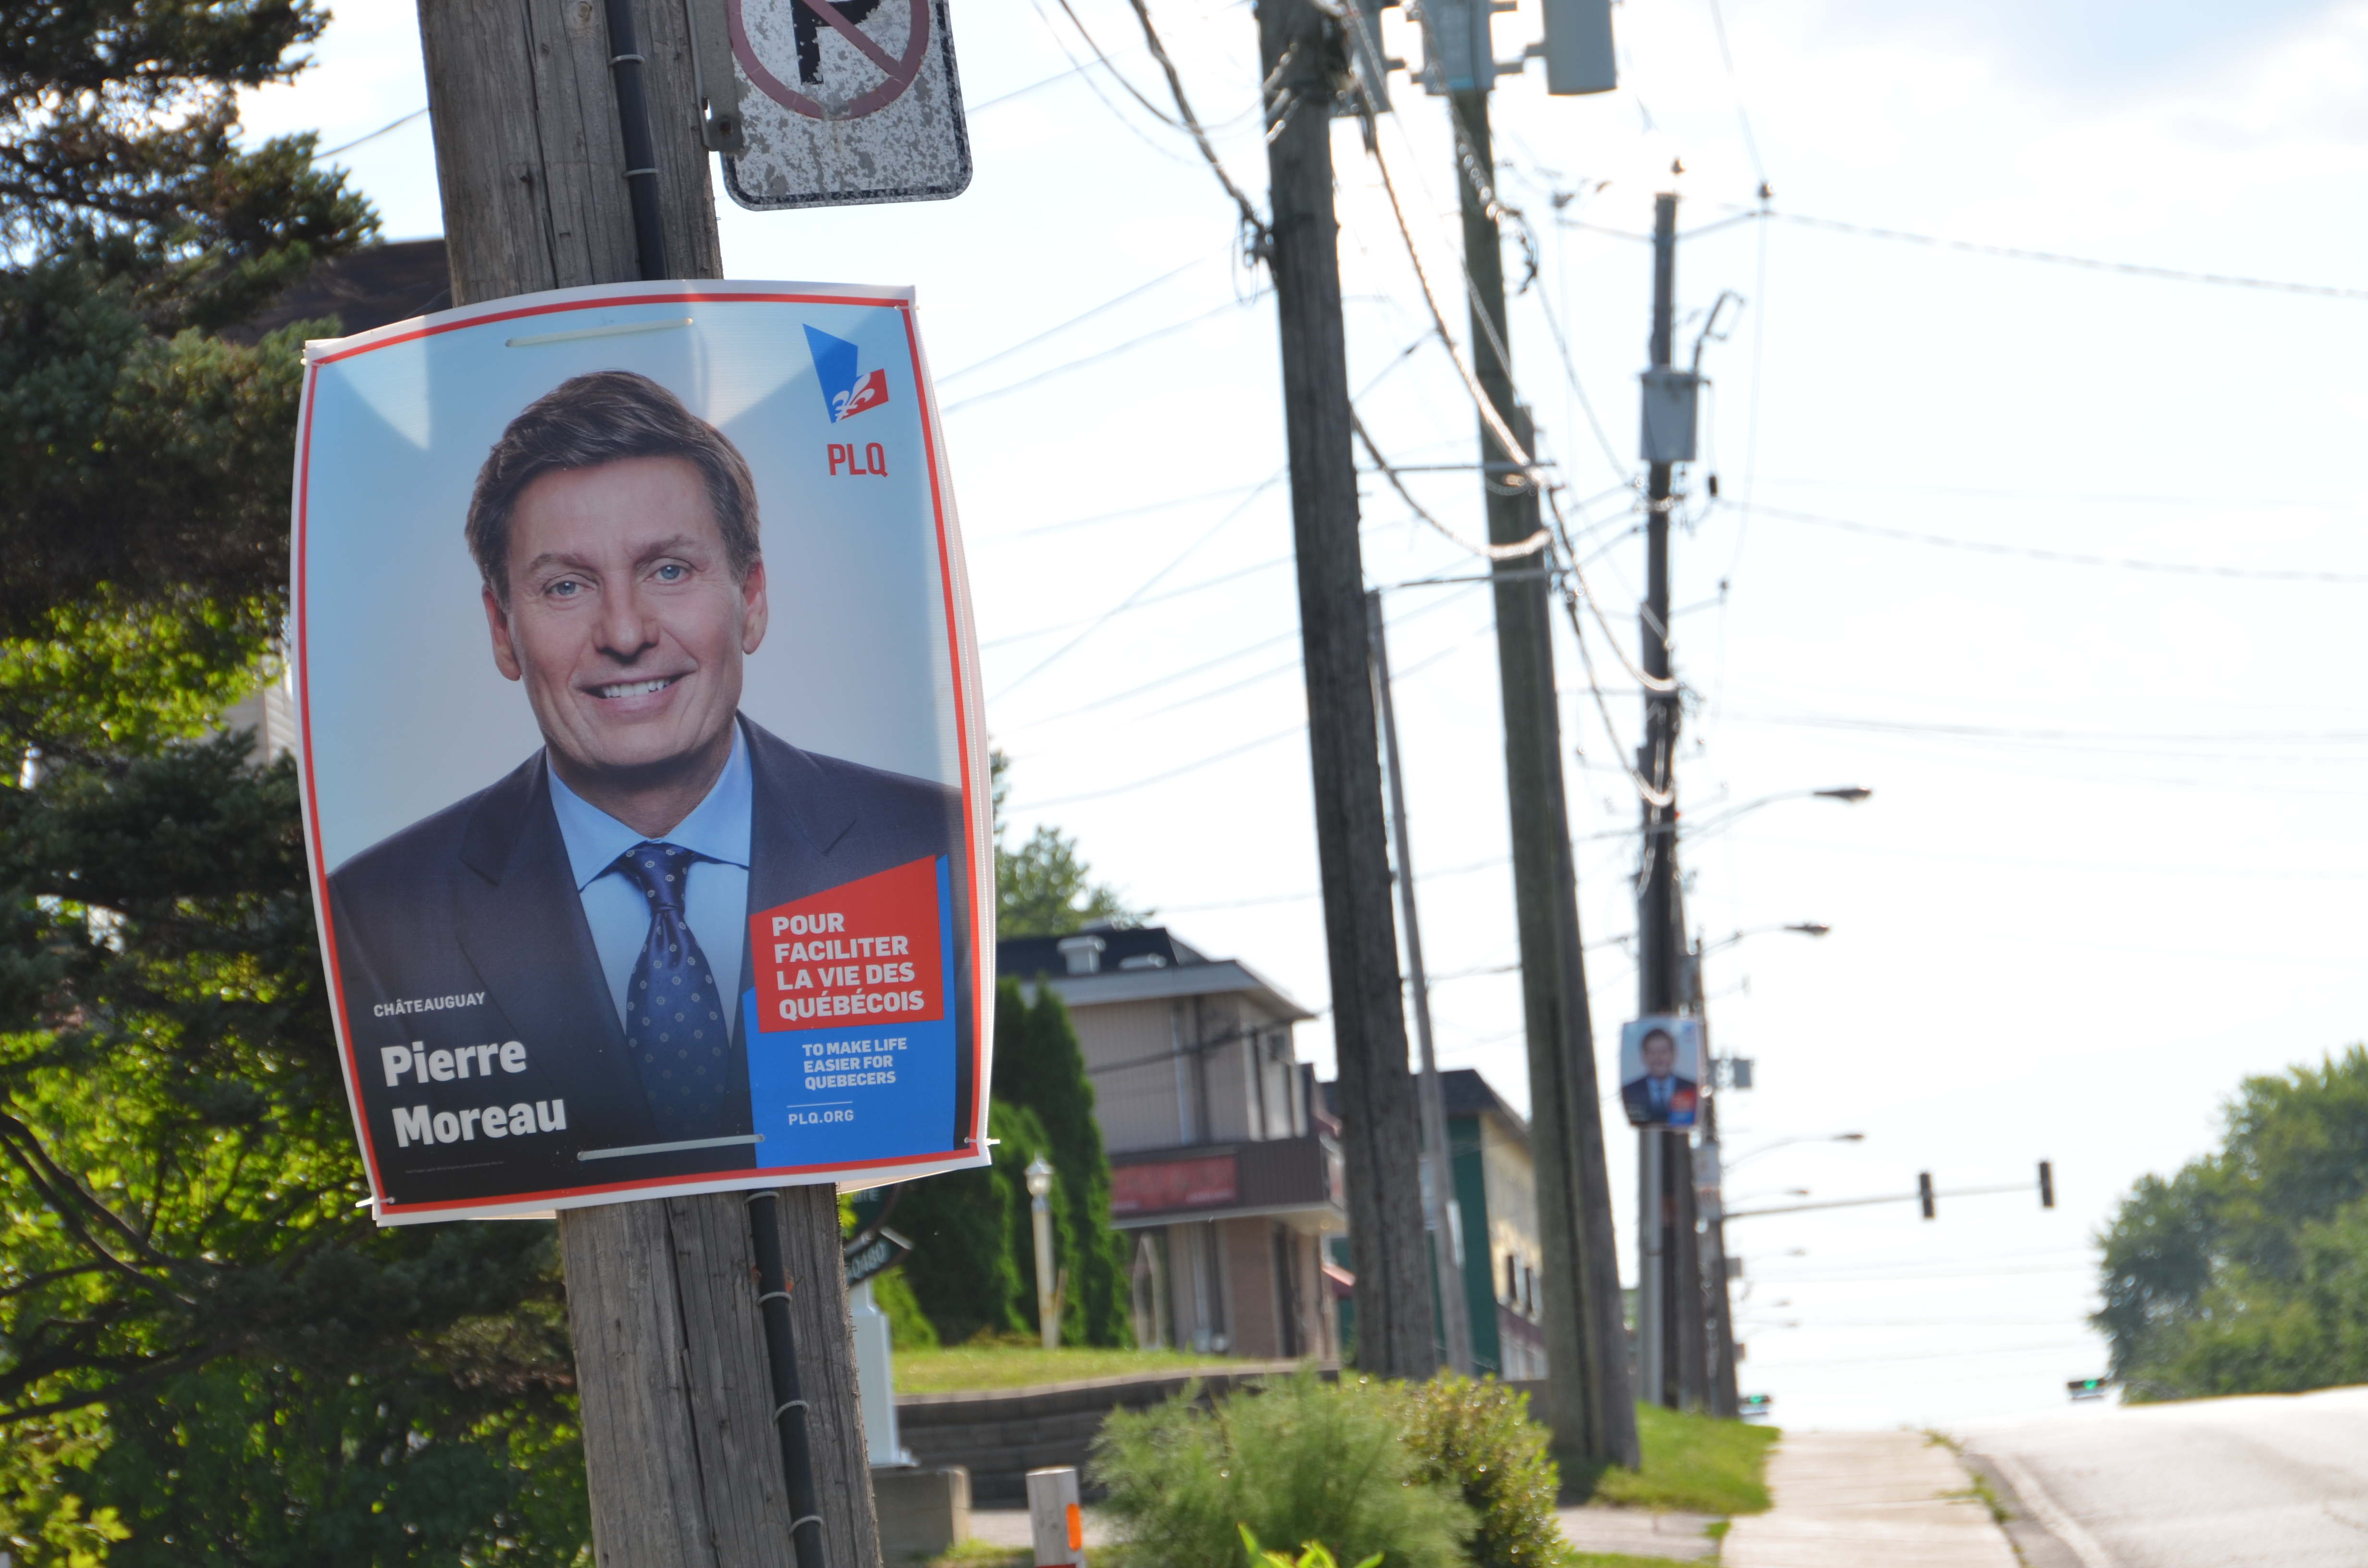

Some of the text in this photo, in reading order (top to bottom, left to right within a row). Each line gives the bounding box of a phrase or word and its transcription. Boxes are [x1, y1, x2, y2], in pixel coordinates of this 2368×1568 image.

[826, 442, 888, 478] PLQ
[772, 912, 845, 936] POUR
[774, 935, 909, 964] FACILITER
[777, 962, 915, 991] LA VIE DES
[373, 992, 485, 1017] CHÂTEAUGUAY
[778, 990, 925, 1021] QUÉBÉCOIS
[802, 1037, 907, 1056] TO MAKE LIFE
[380, 1041, 527, 1087] Pierre
[803, 1055, 893, 1072] EASIER FOR
[804, 1071, 896, 1091] QUEBECERS
[392, 1099, 567, 1148] Moreau
[788, 1109, 854, 1126] PLQ.ORG
